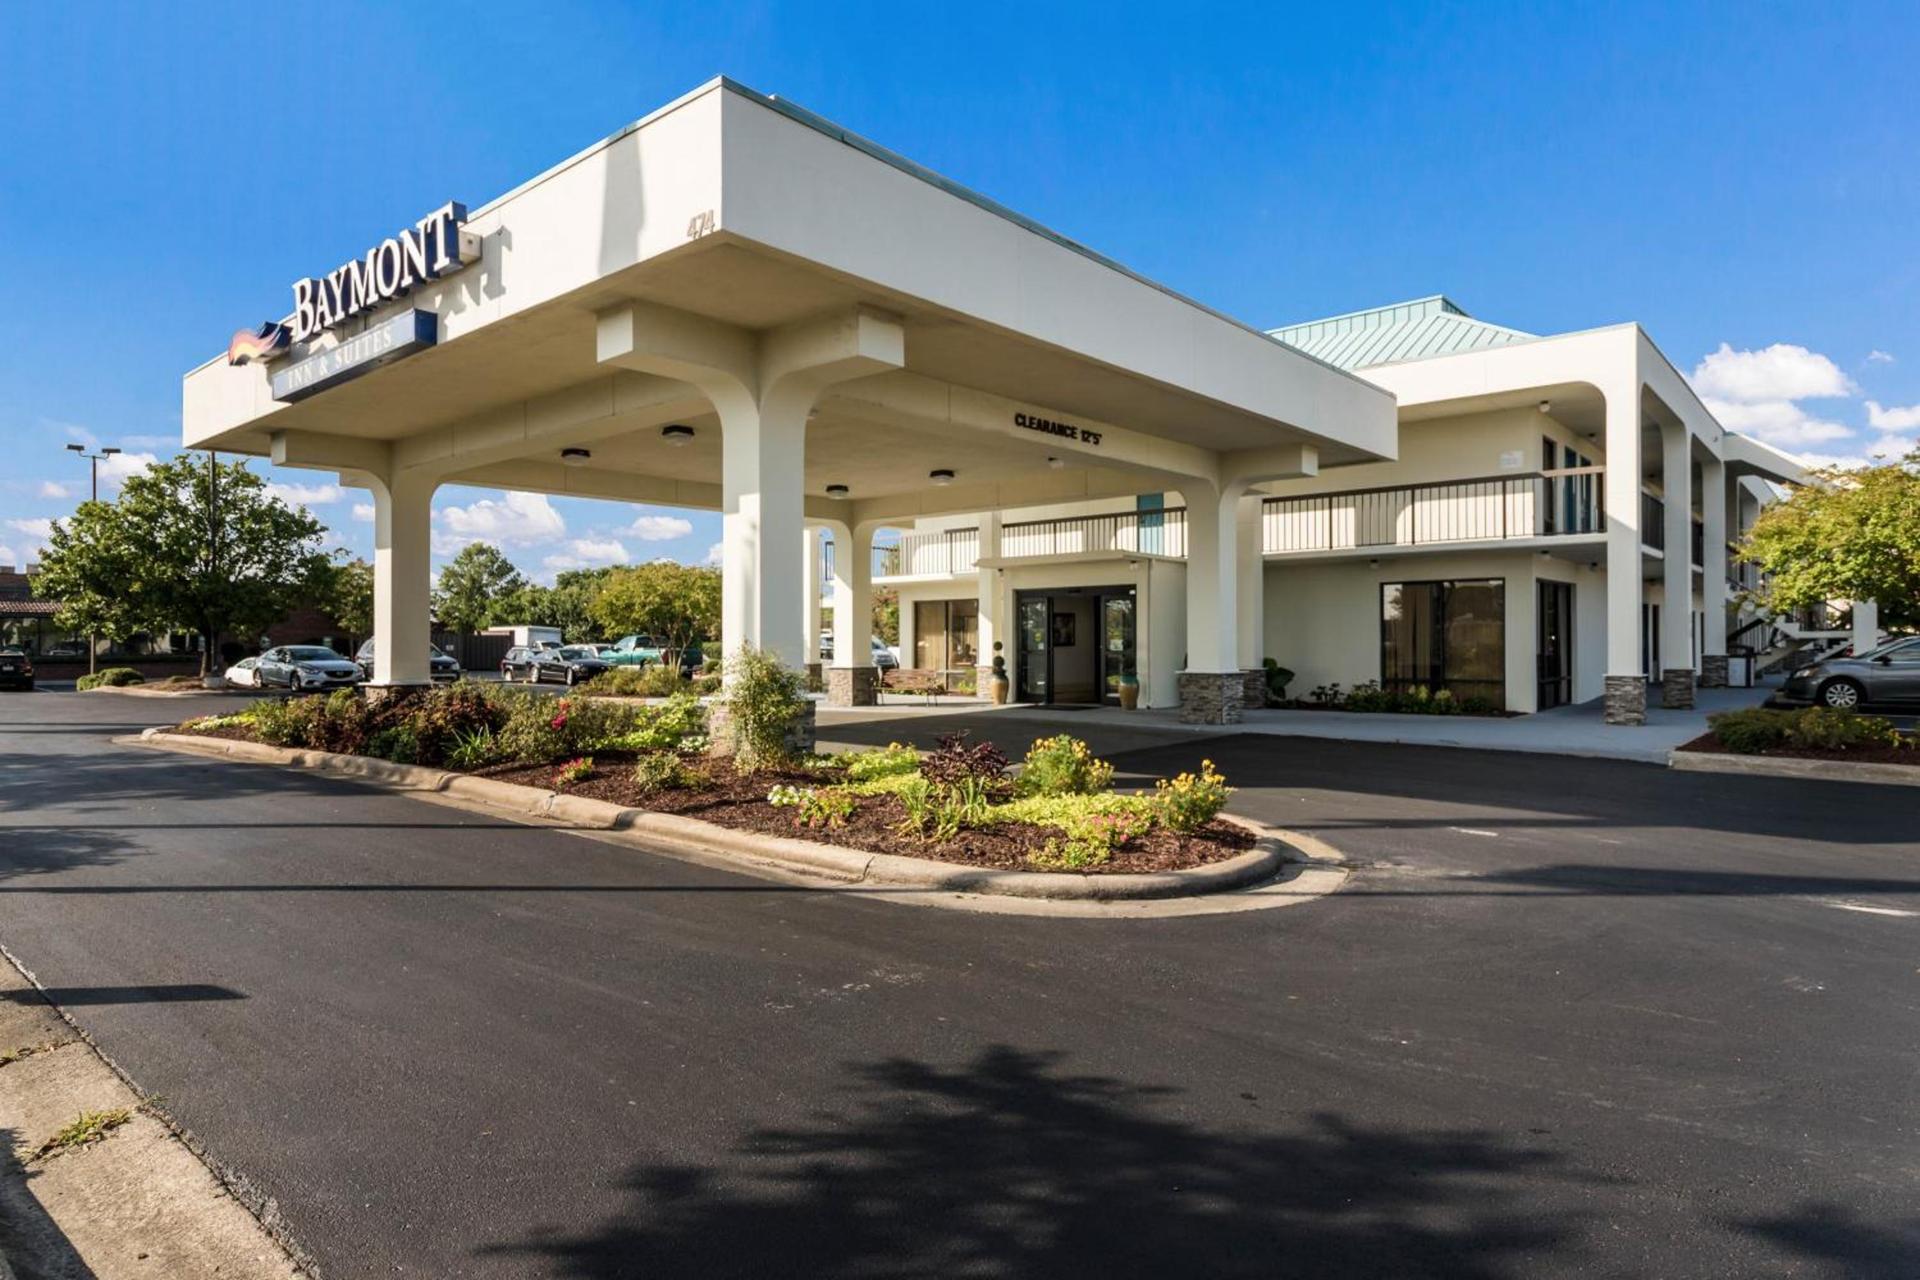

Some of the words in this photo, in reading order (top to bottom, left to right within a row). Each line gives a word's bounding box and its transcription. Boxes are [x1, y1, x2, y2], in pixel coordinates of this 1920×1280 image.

[687, 209, 715, 240] 474
[292, 200, 464, 341] BAYMONT
[288, 362, 312, 389] INN
[336, 325, 391, 369] SUITES
[1014, 413, 1078, 440] CLEARANCE
